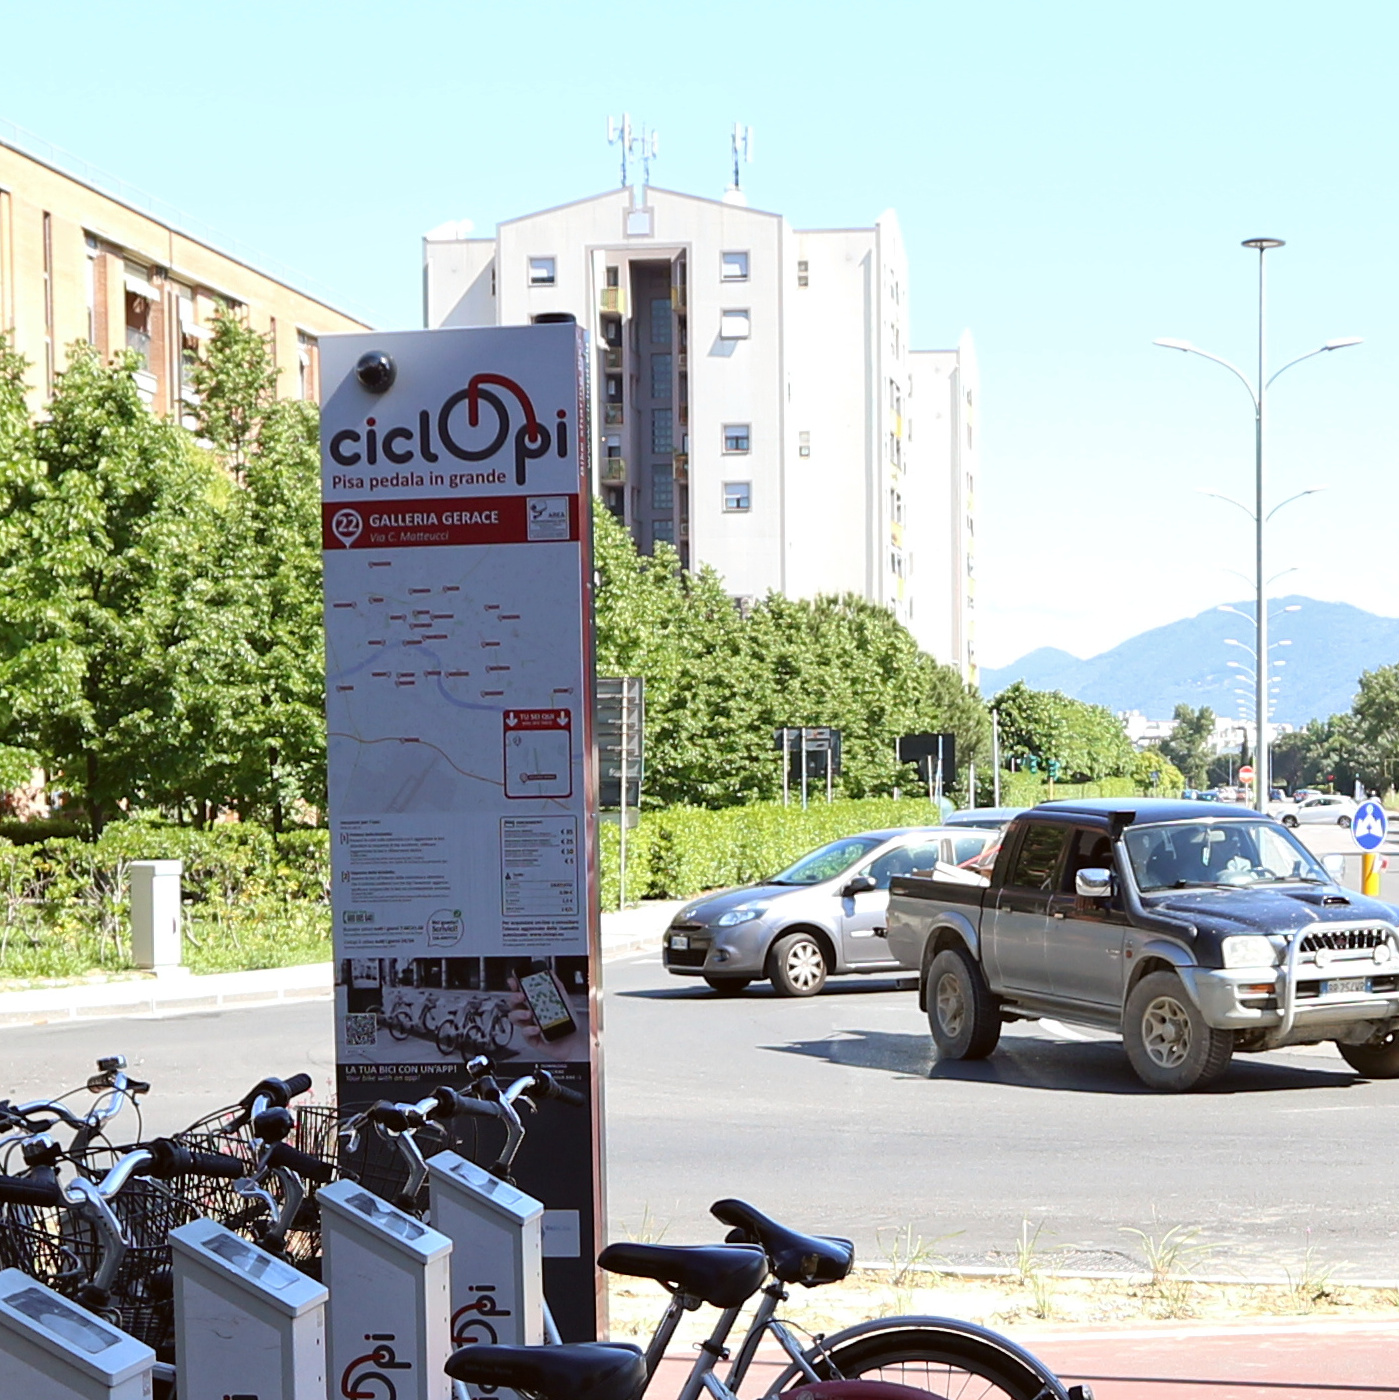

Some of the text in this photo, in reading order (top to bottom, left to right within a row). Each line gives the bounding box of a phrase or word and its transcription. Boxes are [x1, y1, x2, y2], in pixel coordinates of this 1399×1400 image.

[332, 468, 507, 492] Pisa pedala in grande
[338, 510, 499, 532] 22 GALLERIA GERACE
[358, 1065, 377, 1074] TUA
[378, 1065, 396, 1074] BICI
[398, 1065, 418, 1074] CON
